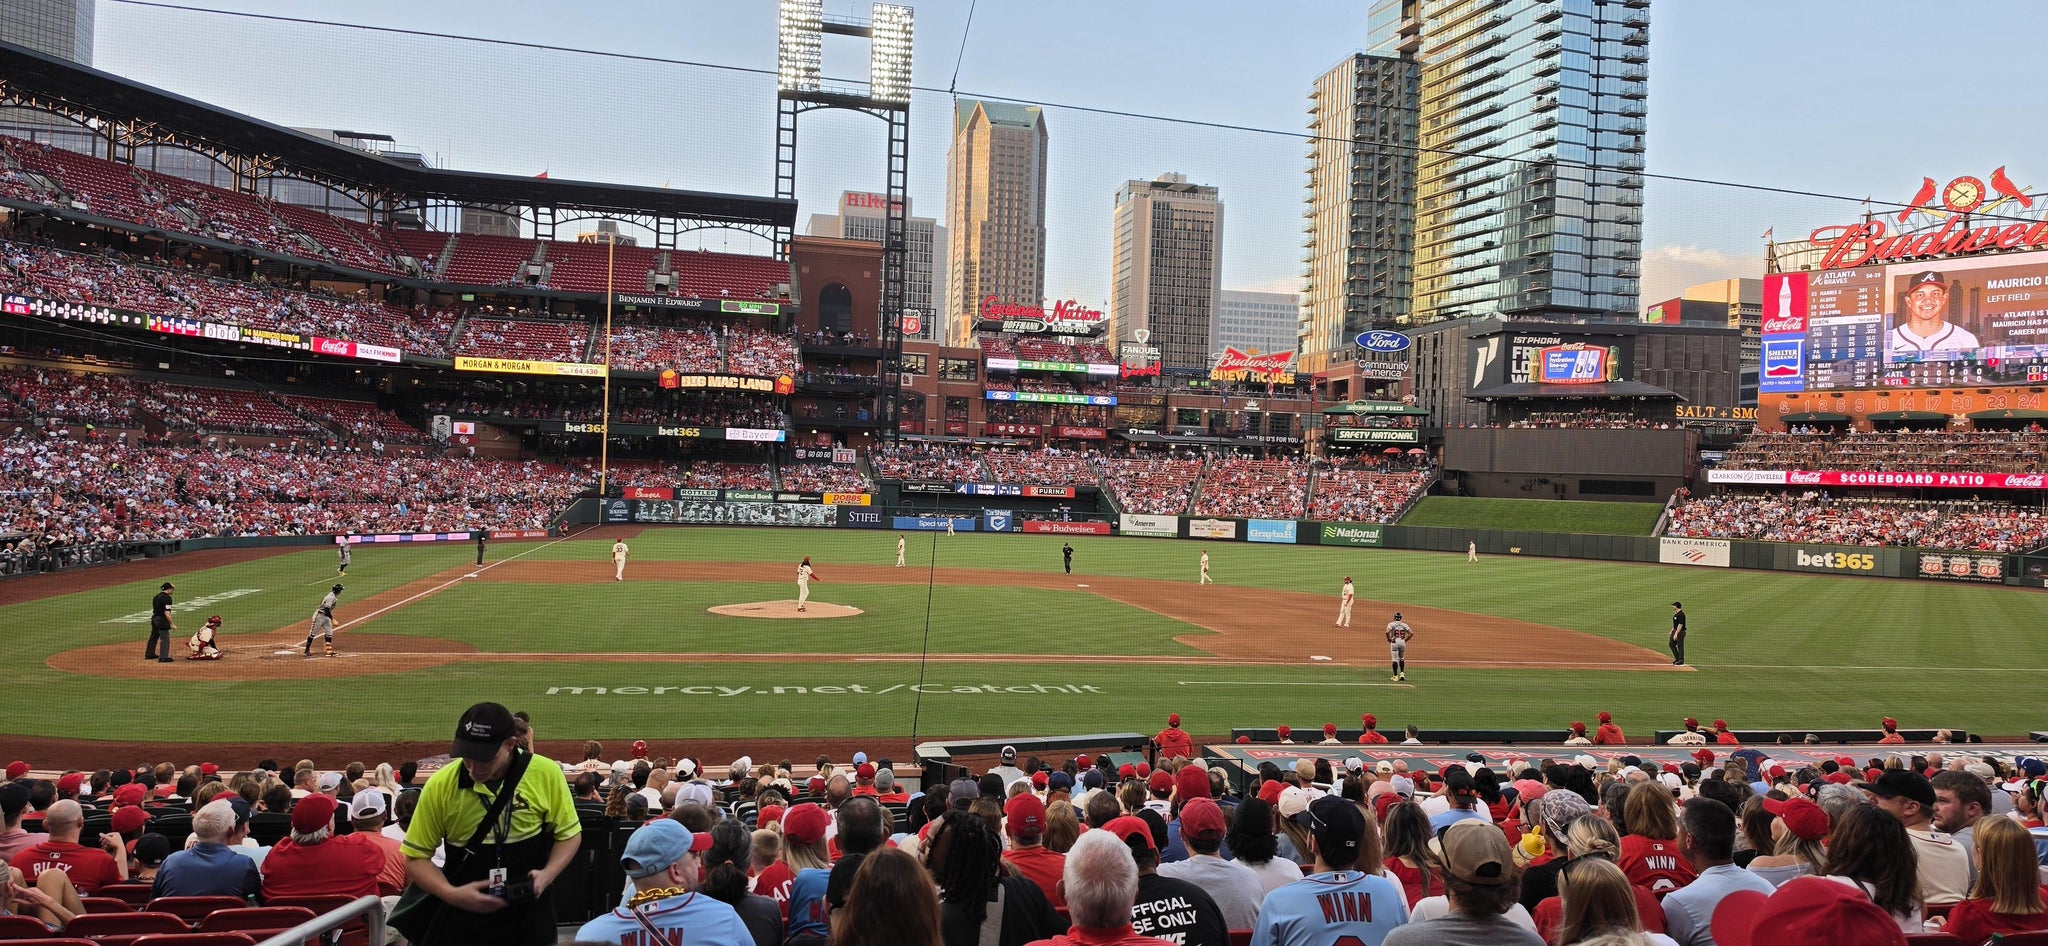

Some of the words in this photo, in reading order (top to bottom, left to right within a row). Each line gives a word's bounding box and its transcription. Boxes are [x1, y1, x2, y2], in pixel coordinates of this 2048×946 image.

[1987, 276, 2042, 290] MAURICIO
[14, 296, 26, 304] ATL
[618, 294, 656, 304] BENJAMIN
[665, 298, 700, 307] EDWARDS
[1987, 294, 2006, 302] LEFT
[2008, 293, 2030, 301] FIELD
[14, 305, 26, 313] STL
[981, 295, 1045, 320] Cardinals
[1046, 300, 1102, 324] Nation
[1002, 320, 1040, 330] HOFFMANN
[1052, 325, 1090, 334] ROOFTOP
[1764, 316, 1804, 332] Coca-Cola
[1367, 332, 1401, 349] Ford
[1561, 342, 1586, 351] Coca-Cola
[1122, 346, 1160, 354] FANDUEL
[462, 359, 492, 369] MORGAN
[494, 360, 499, 369] &
[501, 361, 530, 371] MORGAN
[1212, 352, 1294, 370] Budweiser
[1358, 359, 1409, 372] Community
[1121, 361, 1161, 378] Live!
[681, 376, 706, 387] BIG
[708, 376, 738, 388] MAC
[740, 378, 774, 390] LAND
[1210, 370, 1248, 382] BREW
[1251, 371, 1295, 385] HOUSE
[1804, 400, 1810, 413] 1
[1818, 400, 1828, 412] 2
[1836, 399, 1846, 412] 6
[1855, 398, 1864, 412] 9
[1874, 398, 1889, 411] 10
[1899, 397, 1915, 411] 14
[1925, 396, 1941, 411] 17
[1951, 396, 1972, 410] 20
[1986, 395, 2008, 409] 23
[2018, 394, 2040, 409] 24
[1676, 405, 1716, 418] SALT
[1732, 407, 1758, 419] SMO
[658, 427, 700, 437] bet365
[742, 430, 769, 439] Bayer
[1338, 430, 1370, 440] SAFETY
[1372, 431, 1414, 441] NATIONAL
[1790, 472, 1822, 483] Coca-Cola
[1840, 474, 1934, 484] SCOREBOARD
[1940, 475, 1984, 485] PATIO
[2004, 475, 2044, 487] Coca-Cola
[848, 510, 881, 523] STIFEL
[1336, 527, 1378, 538] National
[1797, 550, 1874, 570] bet365
[1925, 563, 1939, 571] 66
[1952, 564, 1966, 573] 66
[546, 683, 1108, 696] mercy.net/CatchIt
[1645, 855, 1676, 870] WINN
[1132, 896, 1191, 918] FFICIAL
[1316, 892, 1372, 924] WINN
[1132, 920, 1154, 935] SE
[1158, 911, 1197, 930] ONLY
[620, 928, 683, 946] WINN
